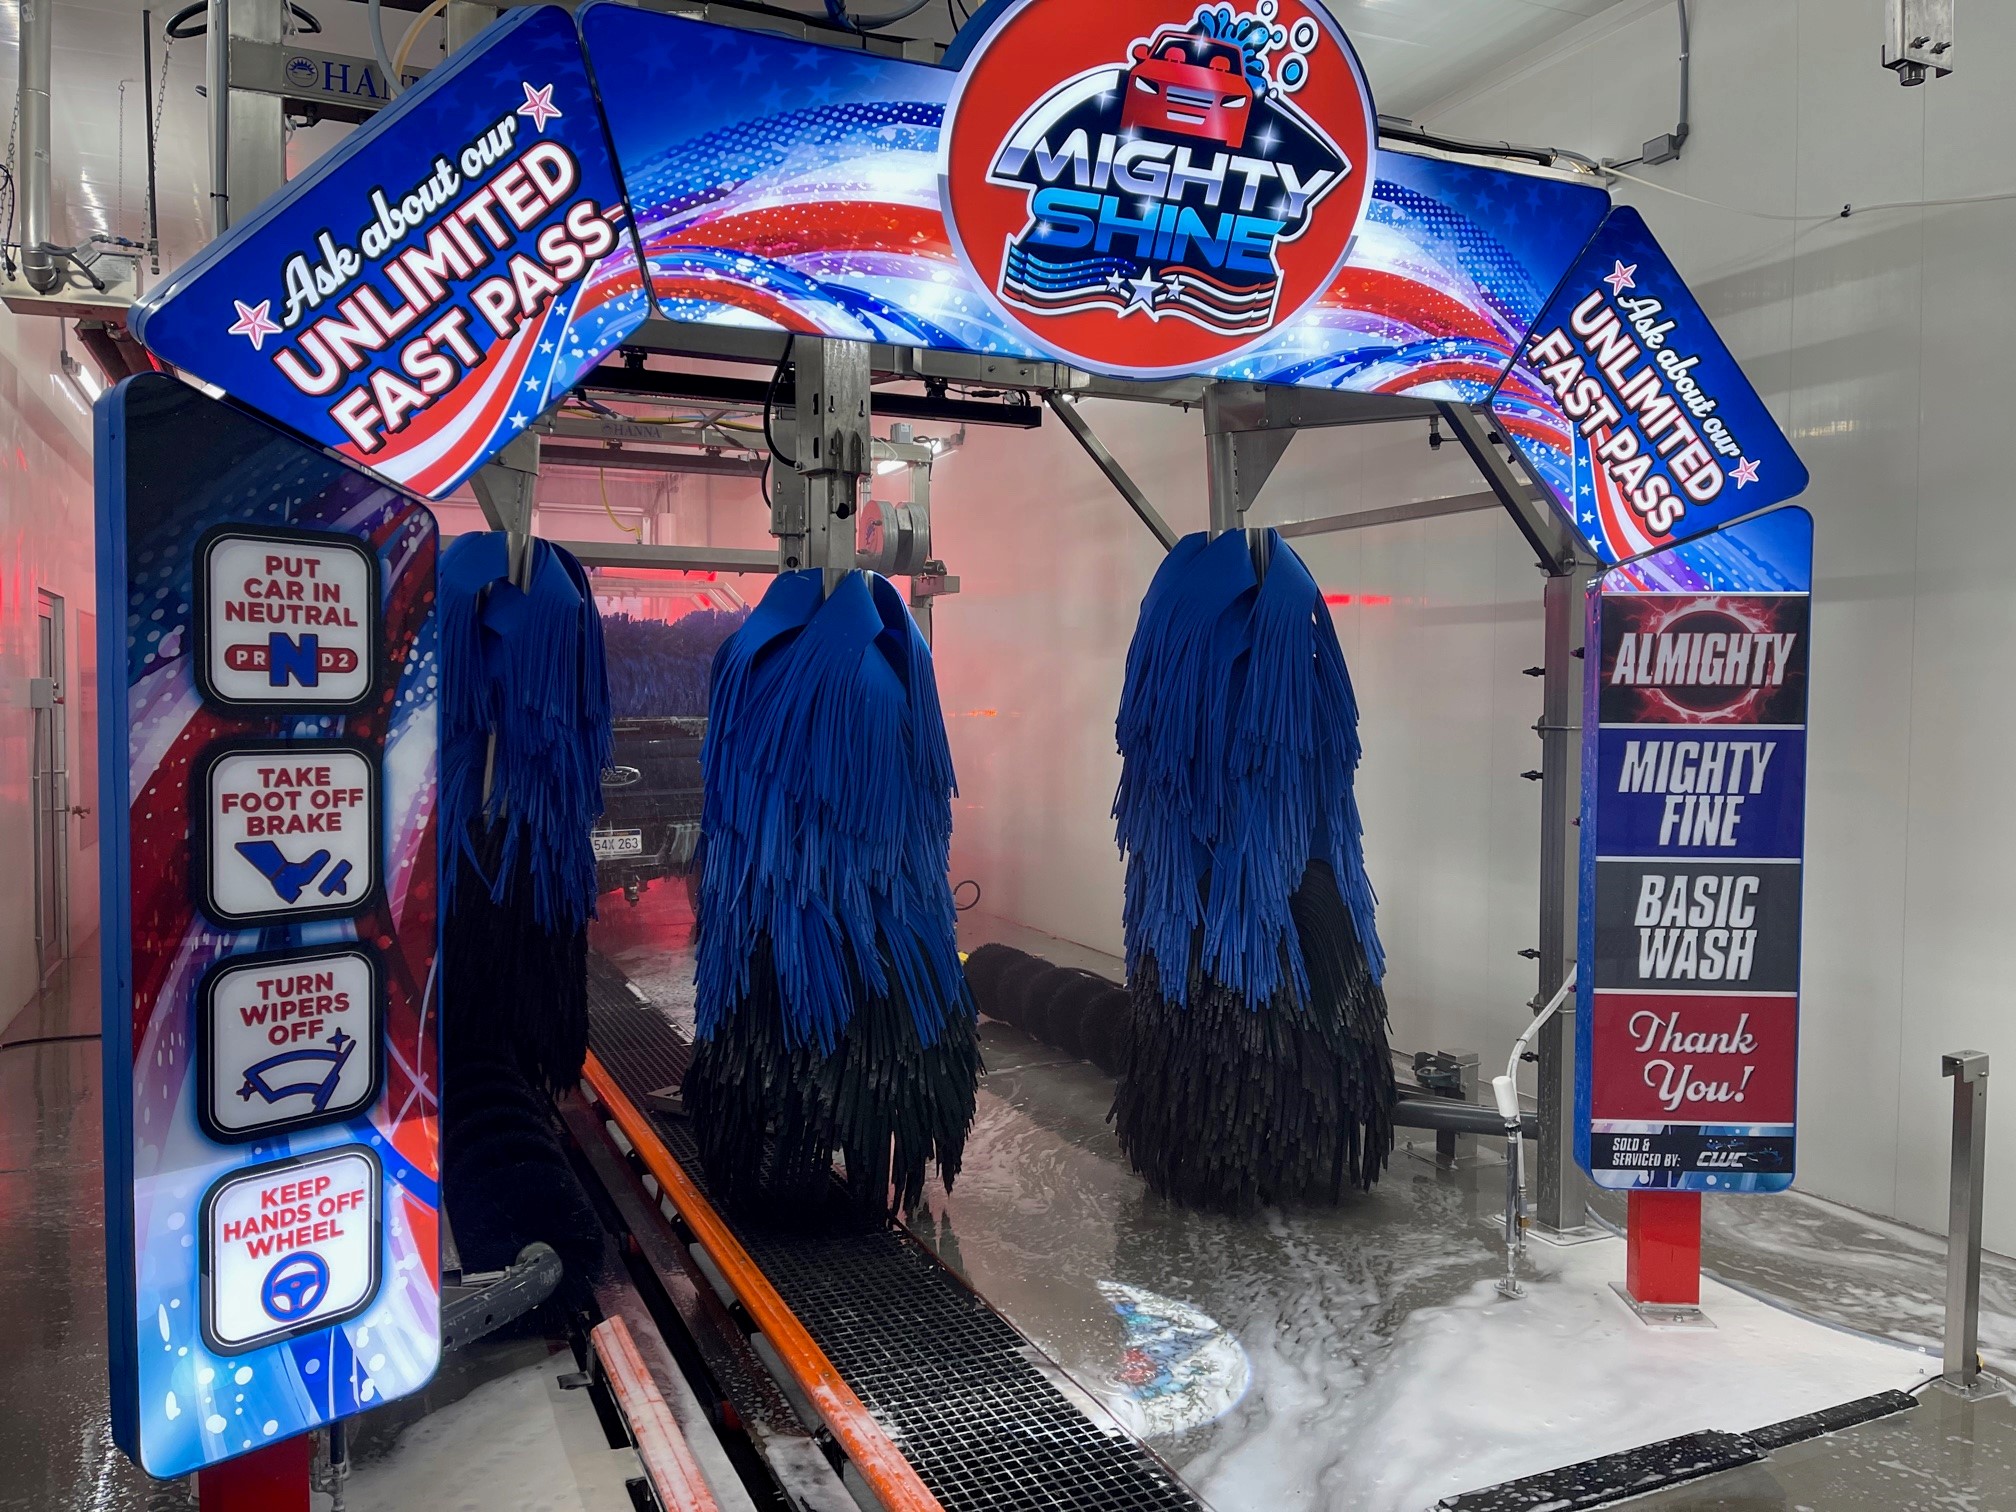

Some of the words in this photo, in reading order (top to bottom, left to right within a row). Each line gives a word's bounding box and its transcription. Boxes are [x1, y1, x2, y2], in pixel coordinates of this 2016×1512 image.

[995, 127, 1336, 218] MIGHTY
[284, 232, 361, 326] Ask
[361, 158, 459, 257] about
[460, 115, 517, 177] our
[1026, 187, 1288, 275] SHINE
[273, 141, 574, 395] UNLIMITED
[329, 306, 479, 453] FAST
[469, 201, 614, 339] PASS
[1570, 290, 1724, 501] UNLIMITED
[1617, 296, 1675, 350] Ask
[1657, 349, 1717, 417] about
[1703, 417, 1740, 457] our
[613, 424, 661, 438] HANNA
[1528, 327, 1620, 435] FAST
[1597, 425, 1684, 533] PASS
[266, 555, 320, 578] PUT
[244, 578, 304, 601] CAR
[313, 582, 340, 603] IN
[225, 601, 358, 627] NEUTRAL
[1611, 632, 1797, 686] ALMIGHTY
[257, 766, 331, 788] TAKE
[1618, 741, 1777, 794] MIGHTY
[221, 791, 301, 814] FOOT
[310, 788, 364, 810] OFF
[1659, 795, 1745, 847] FINE
[246, 812, 342, 836] BRAKE
[594, 838, 615, 851] 54X
[618, 837, 639, 850] 263
[1634, 875, 1760, 928] BASIC
[1638, 928, 1758, 980] WASH
[256, 971, 333, 1000] TURN
[239, 992, 350, 1027] WIPERS
[268, 1019, 324, 1045] OFF
[1629, 1010, 1759, 1055] Thank
[1643, 1059, 1756, 1112] You!
[1612, 1138, 1637, 1151] SOLD
[1641, 1138, 1650, 1151] &
[1612, 1152, 1661, 1167] SERVICED
[1663, 1153, 1681, 1168] BY:
[260, 1176, 331, 1210] KEEP
[223, 1203, 312, 1243] HANDS
[317, 1189, 365, 1217] OFF
[246, 1219, 344, 1260] WHEEL
